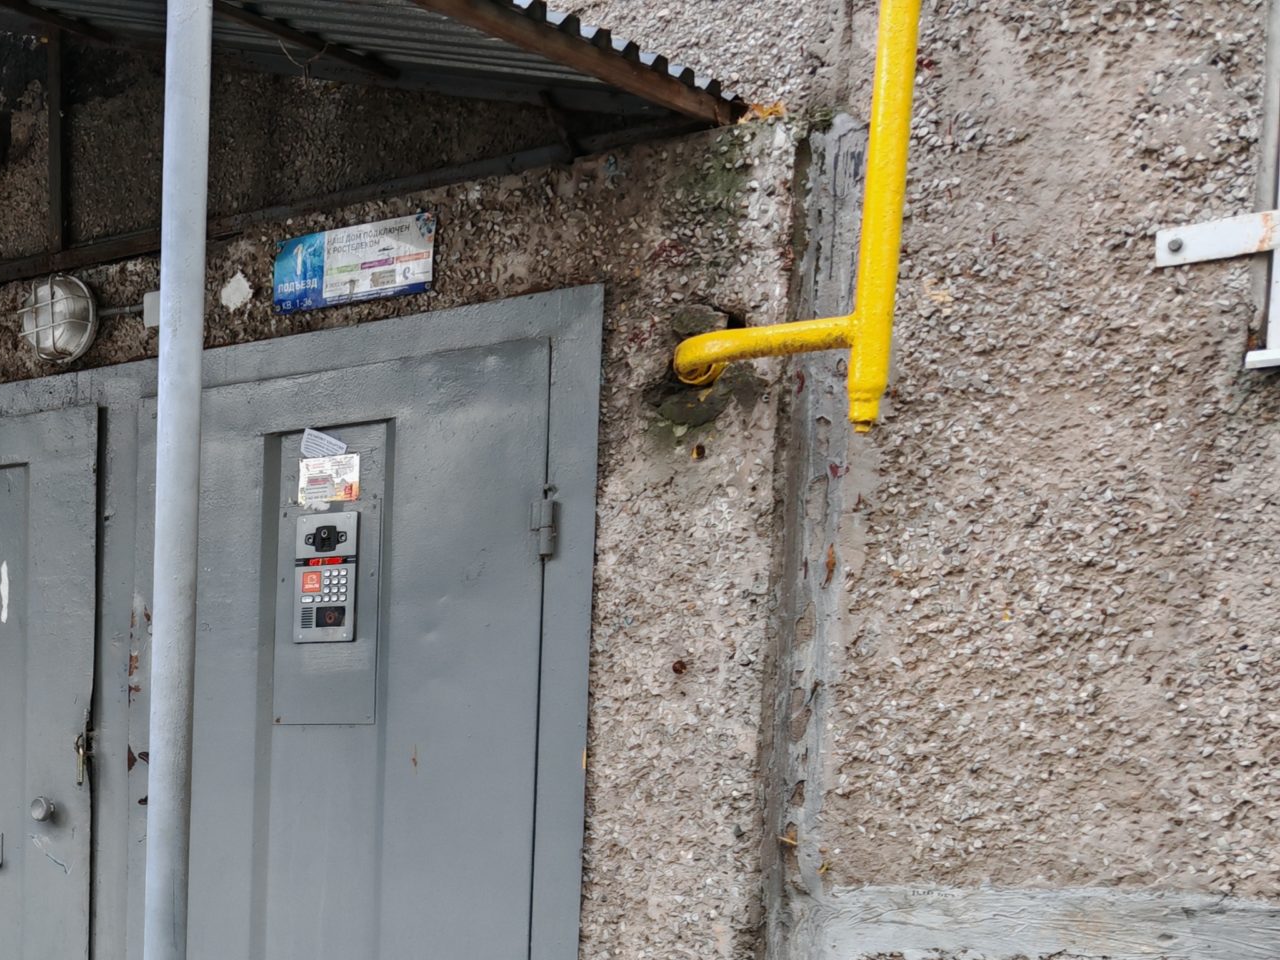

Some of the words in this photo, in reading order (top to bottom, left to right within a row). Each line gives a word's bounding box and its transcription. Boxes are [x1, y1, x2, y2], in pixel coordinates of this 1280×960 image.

[327, 233, 344, 245] НАШ
[345, 231, 362, 244] ДОМ
[363, 224, 410, 239] ПОДКЛЮЧЕН
[292, 243, 304, 275] 1
[278, 278, 318, 293] ПОДЪЕЗД
